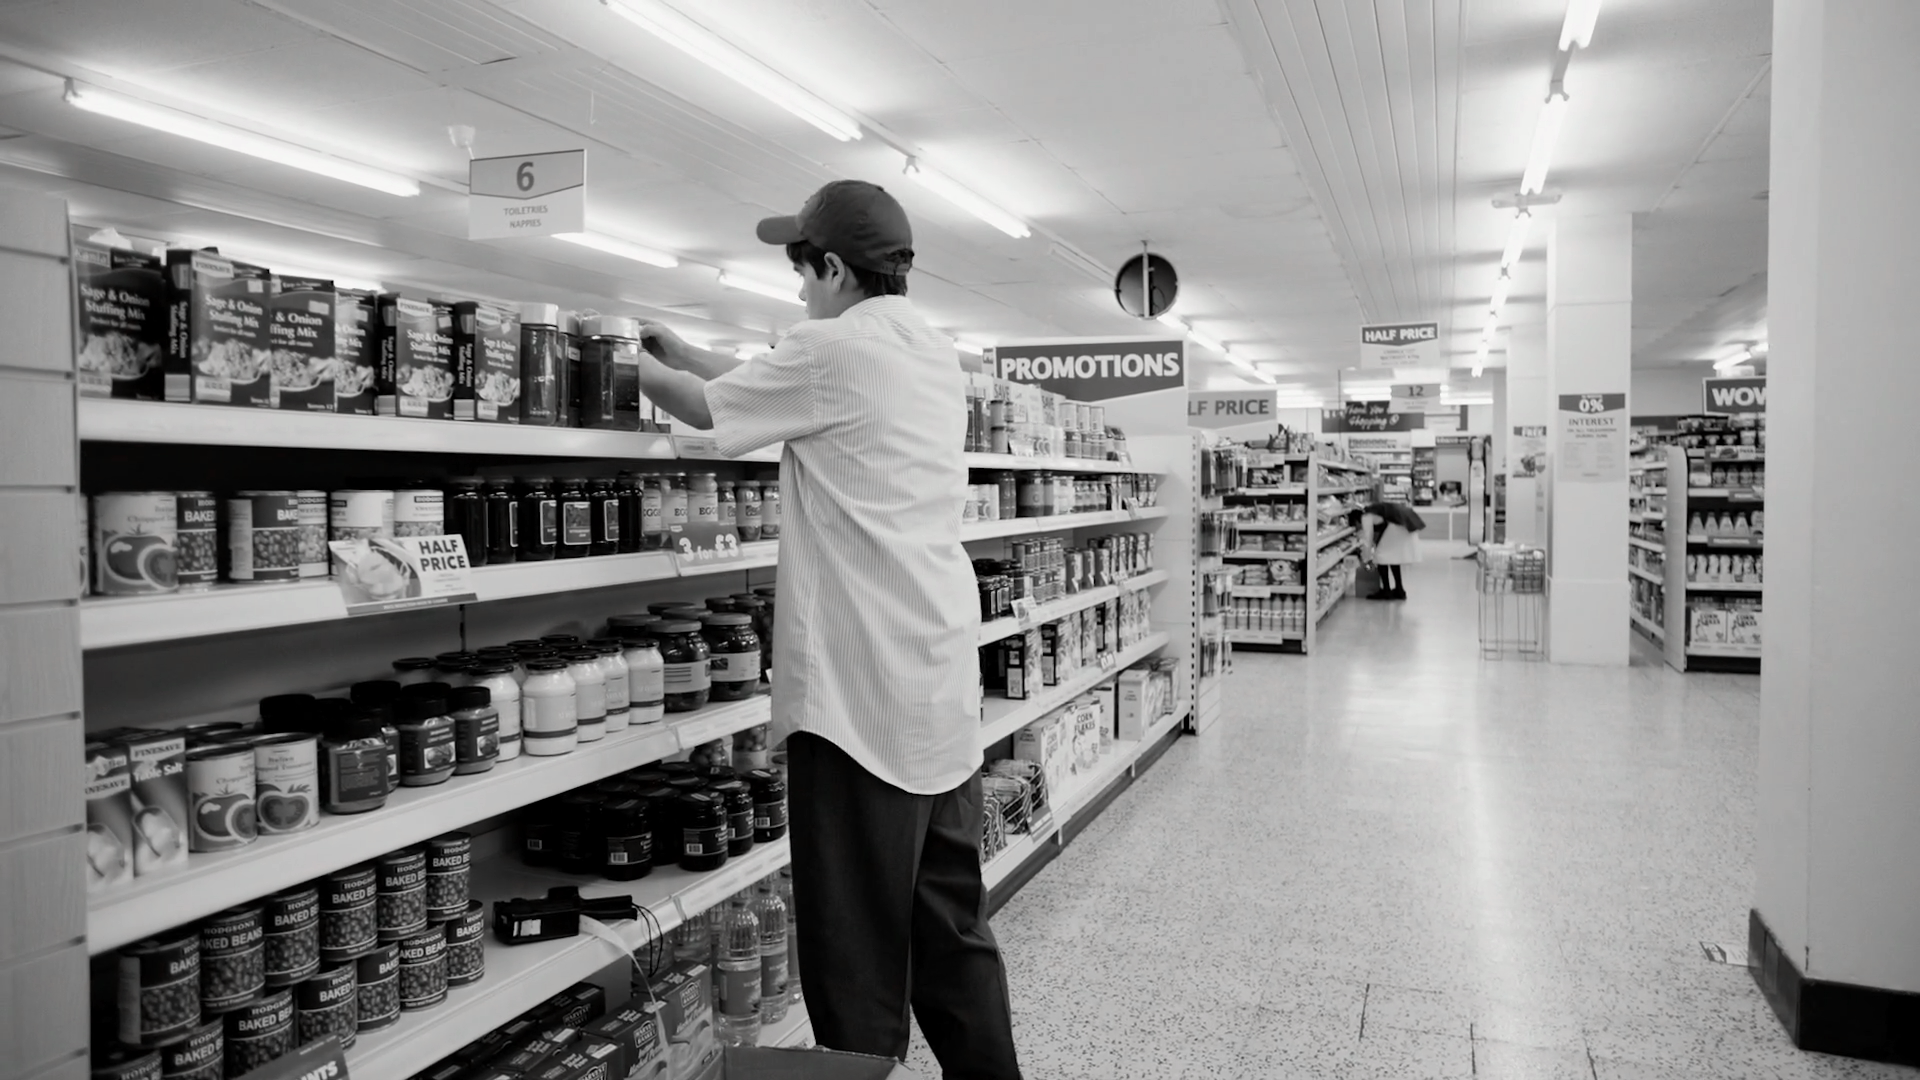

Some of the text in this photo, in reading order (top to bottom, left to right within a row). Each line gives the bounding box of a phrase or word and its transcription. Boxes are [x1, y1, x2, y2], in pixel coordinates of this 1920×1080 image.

[516, 161, 535, 192] 6
[503, 205, 549, 216] TOILETRIES
[509, 219, 542, 228] NAPPIES
[80, 283, 150, 306] Sage & Onion
[85, 299, 146, 320] Stuffing Mix
[205, 293, 263, 315] Sage & Onion
[209, 309, 259, 328] Stuffing Mix
[275, 311, 323, 326] & Onion
[296, 325, 318, 338] Mix
[406, 329, 454, 345] Sage & Onion
[1365, 327, 1435, 341] HALF PRICE
[410, 341, 451, 356] Stuffing Mix
[1001, 352, 1180, 380] PROMOTIONS
[1408, 385, 1424, 397] 12
[1188, 398, 1269, 416] LF PRICE
[1579, 399, 1604, 412] 0%
[1348, 415, 1387, 430] Shopping
[1569, 417, 1615, 426] INTEREST
[418, 539, 459, 556] HALF
[679, 533, 740, 562] 3 for £3
[419, 555, 467, 572] PRICE
[1077, 711, 1094, 724] CORN
[1074, 721, 1096, 735] FLAKES
[134, 743, 181, 758] FINESAVE
[163, 761, 183, 775] Salt
[432, 856, 462, 867] BAKED
[385, 873, 416, 887] BAKED
[332, 888, 365, 904] BAKED
[275, 909, 309, 926] BAKED
[204, 920, 255, 935] HODGSONS
[231, 926, 262, 947] BEANS
[403, 932, 442, 946] HODGSONS
[319, 983, 351, 1003] BAKED
[563, 1004, 591, 1022] HARVEST
[238, 1013, 277, 1031] BAKED
[634, 1021, 656, 1036] HARVEST
[174, 1042, 215, 1066] BAKED
